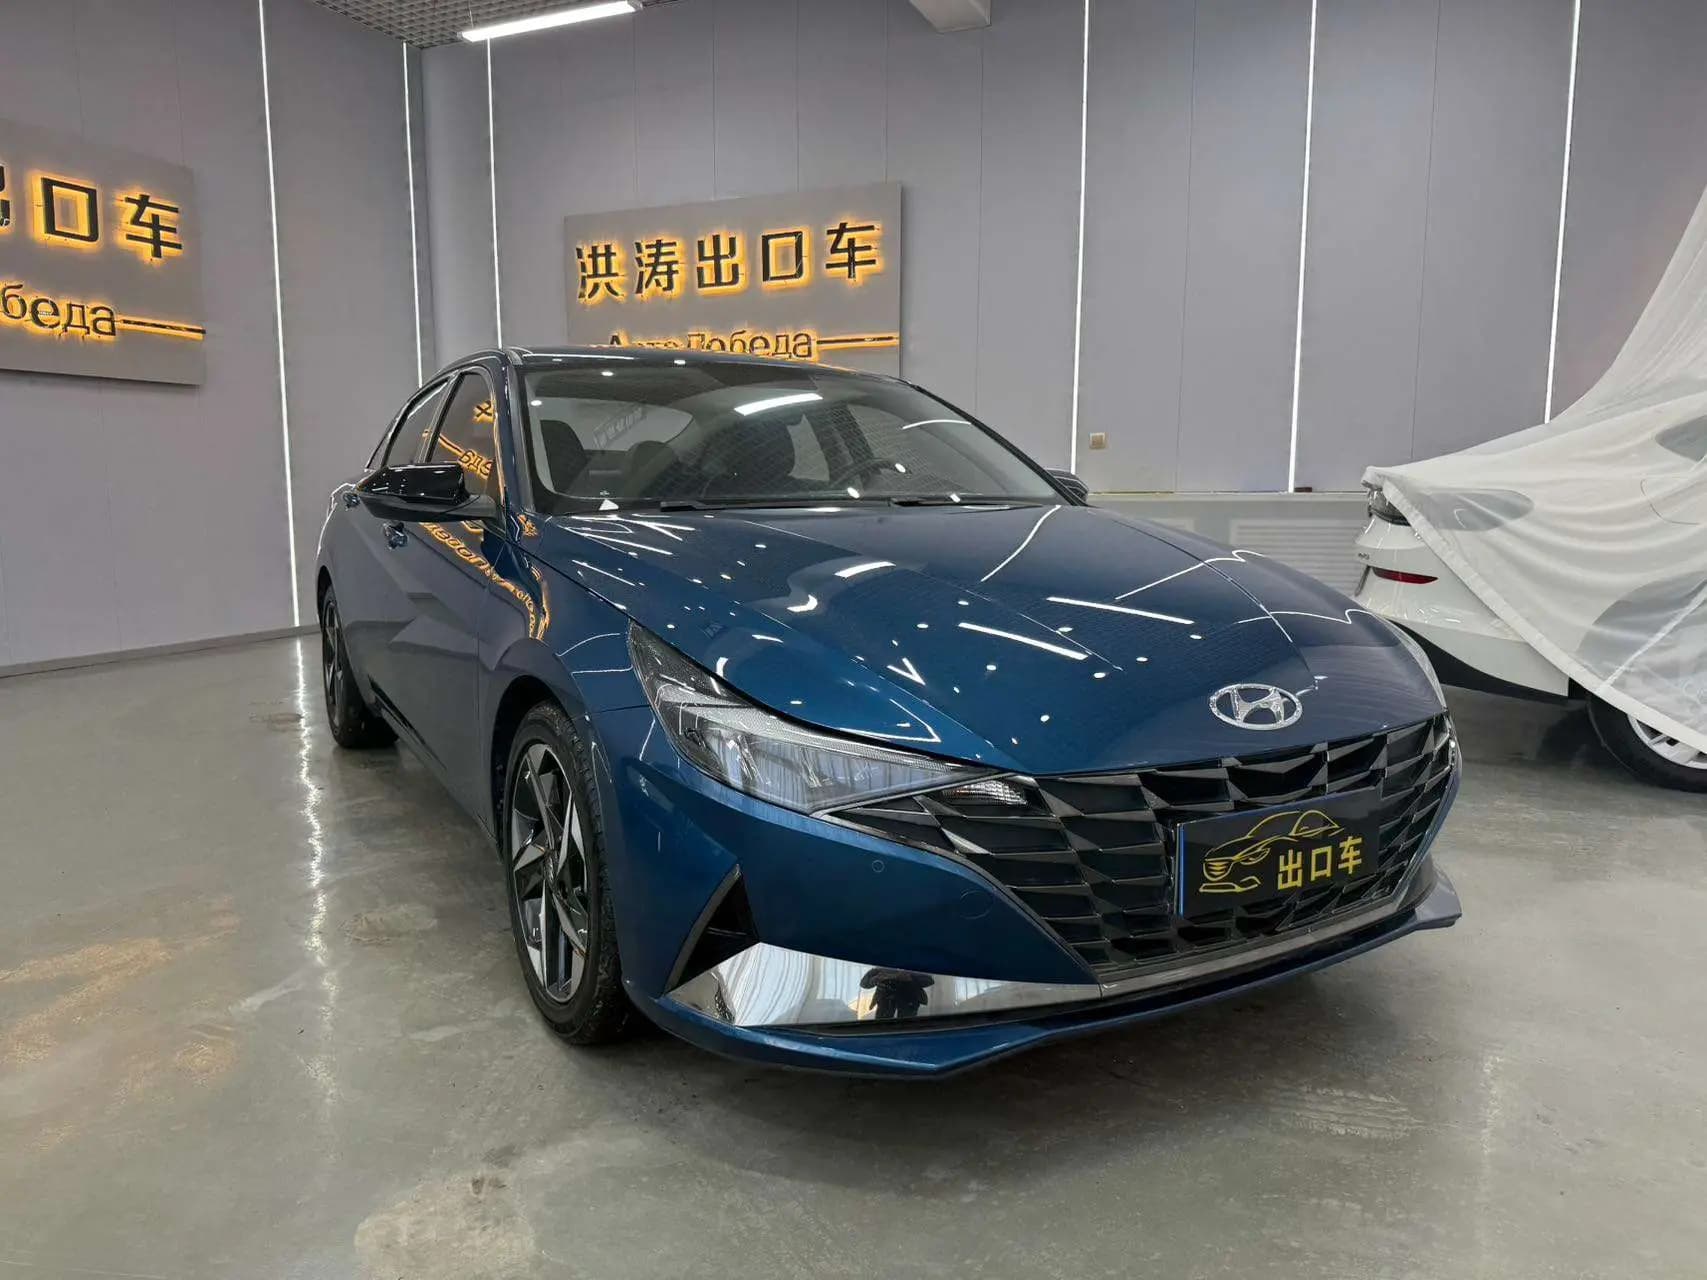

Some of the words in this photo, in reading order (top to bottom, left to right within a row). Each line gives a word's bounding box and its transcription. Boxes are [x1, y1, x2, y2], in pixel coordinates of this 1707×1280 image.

[0, 165, 182, 258] 口车
[576, 222, 877, 299] 洪涛出口车
[1277, 835, 1363, 890] 出口车
